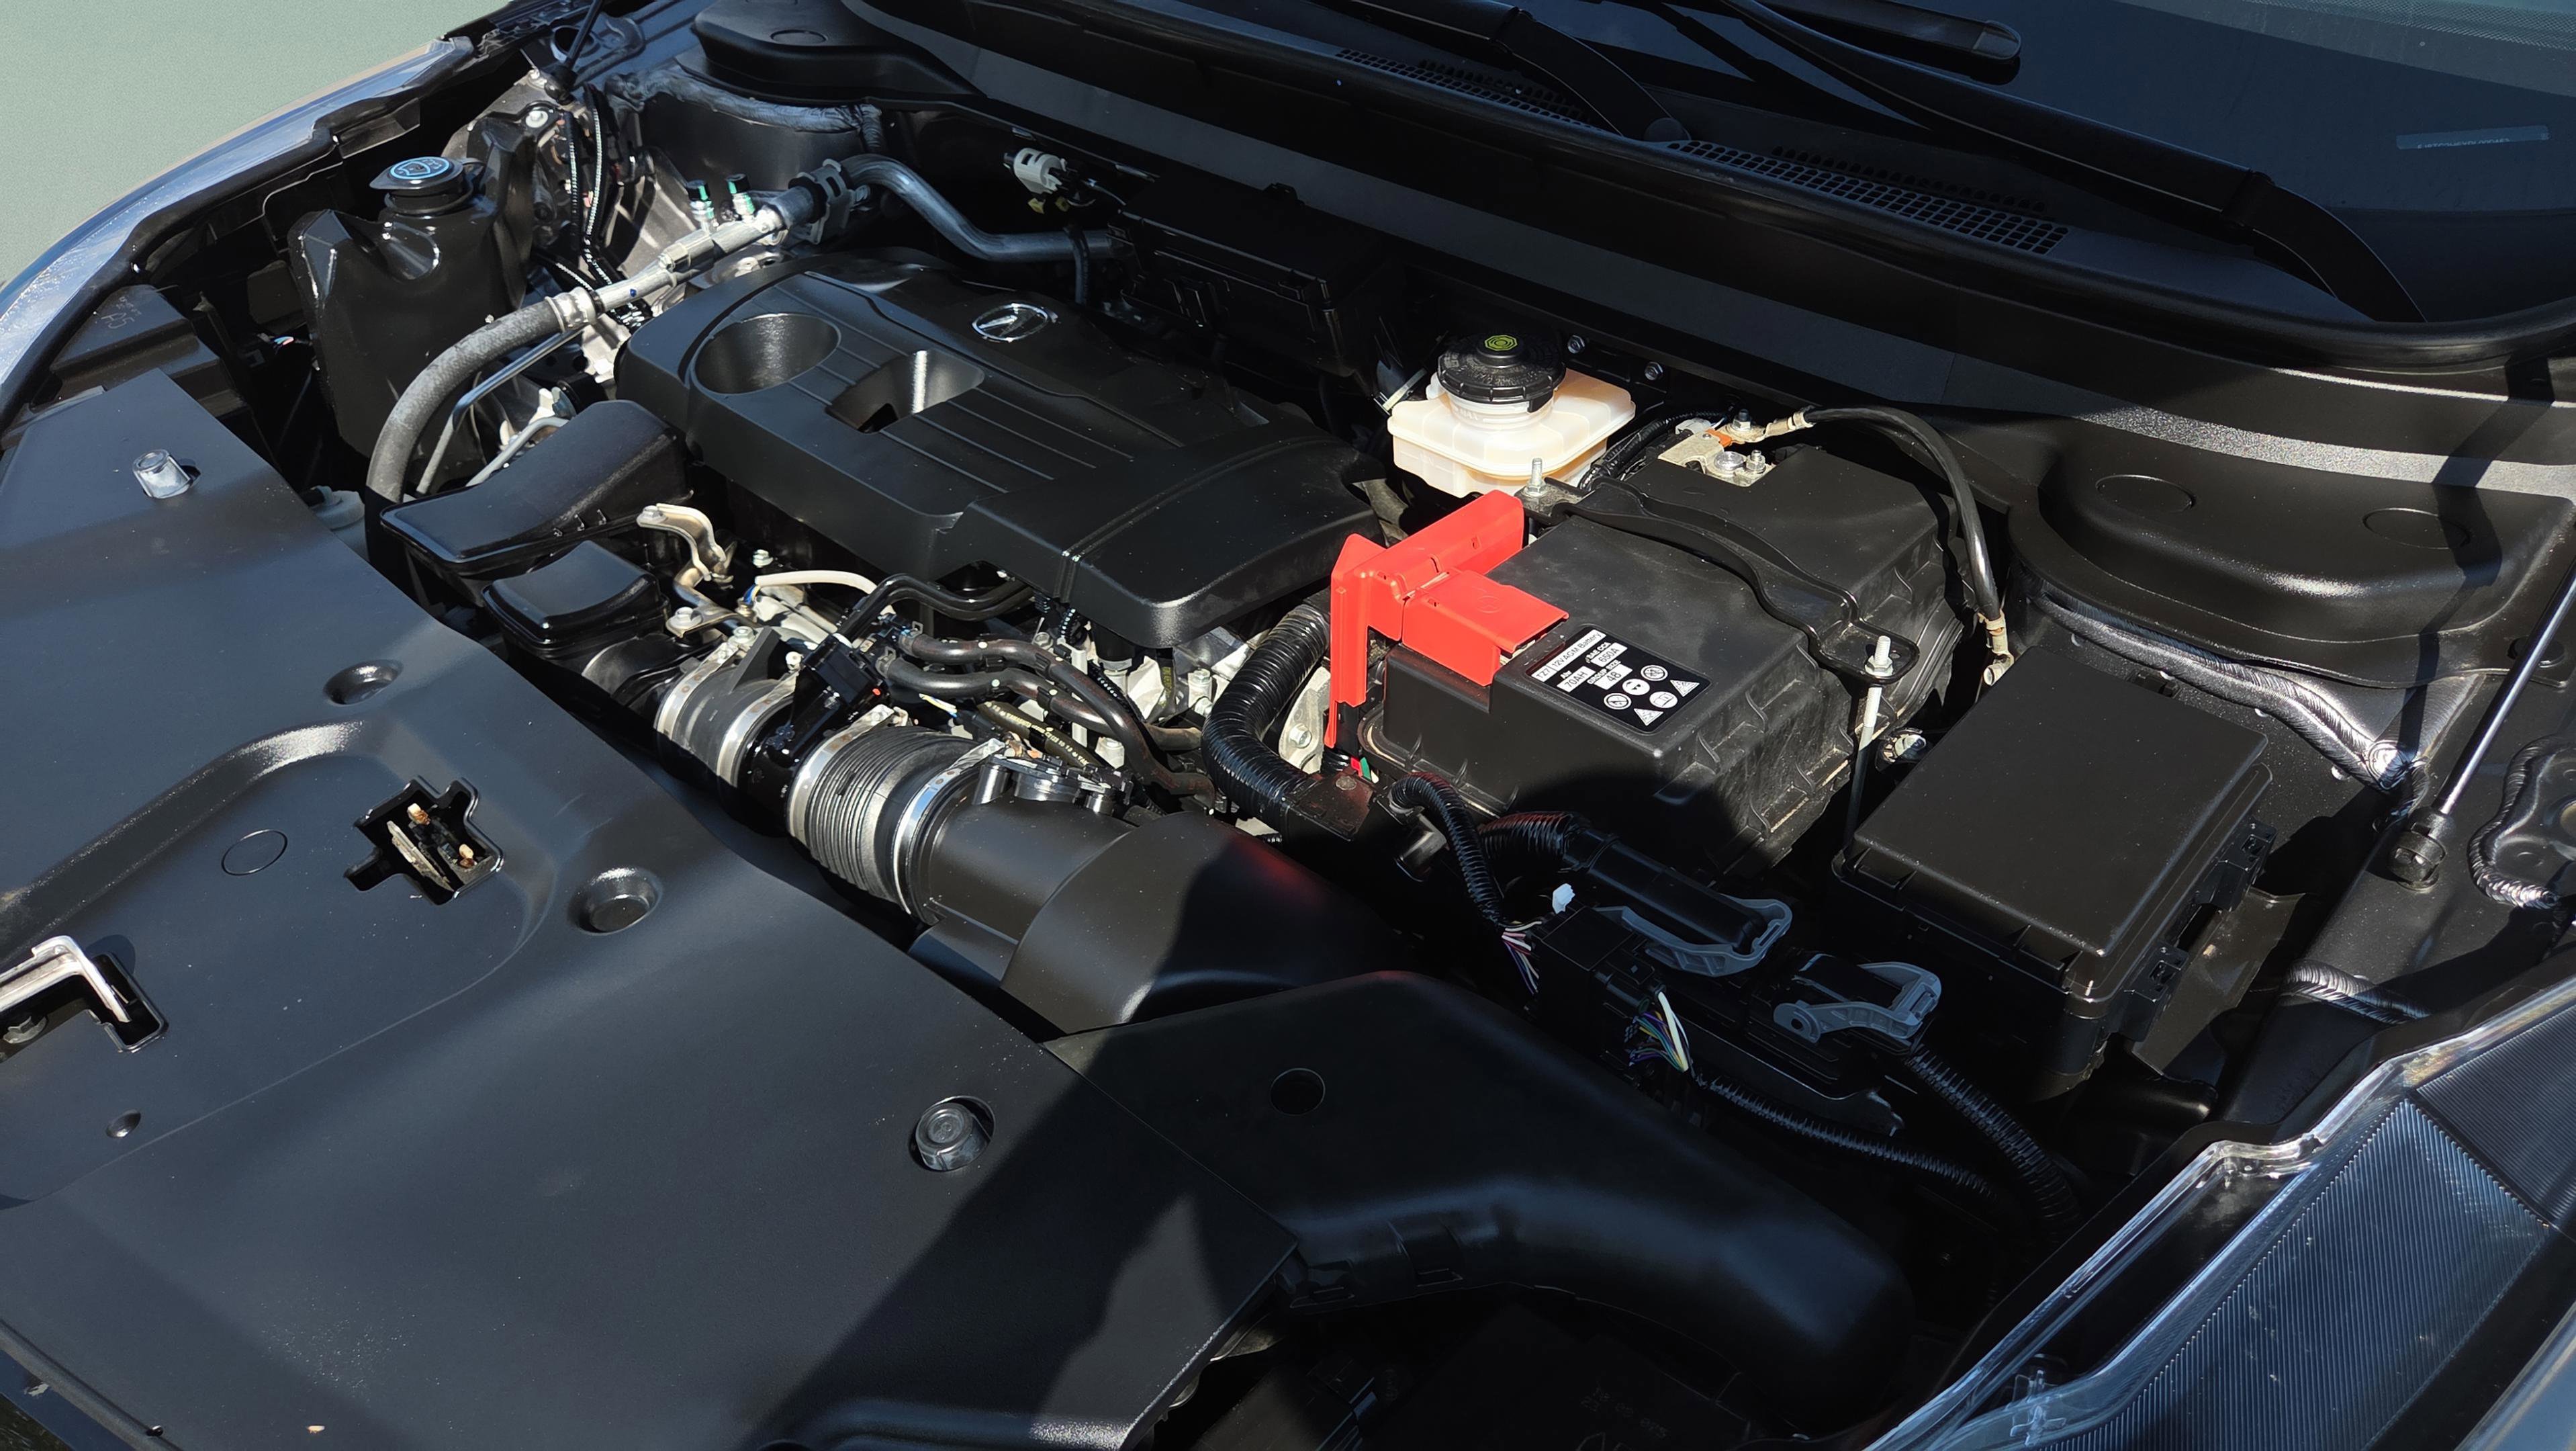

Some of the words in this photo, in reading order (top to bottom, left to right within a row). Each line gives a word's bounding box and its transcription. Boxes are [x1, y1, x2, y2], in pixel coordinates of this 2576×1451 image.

[1536, 668, 1551, 680] TZ7
[1551, 659, 1565, 668] 12V
[1563, 647, 1580, 660] AGM
[1577, 632, 1602, 649] Battery
[1598, 647, 1620, 663] 650A
[1563, 670, 1590, 689] 70AH
[1587, 668, 1608, 685] GROUP
[1606, 670, 1623, 683] 48
